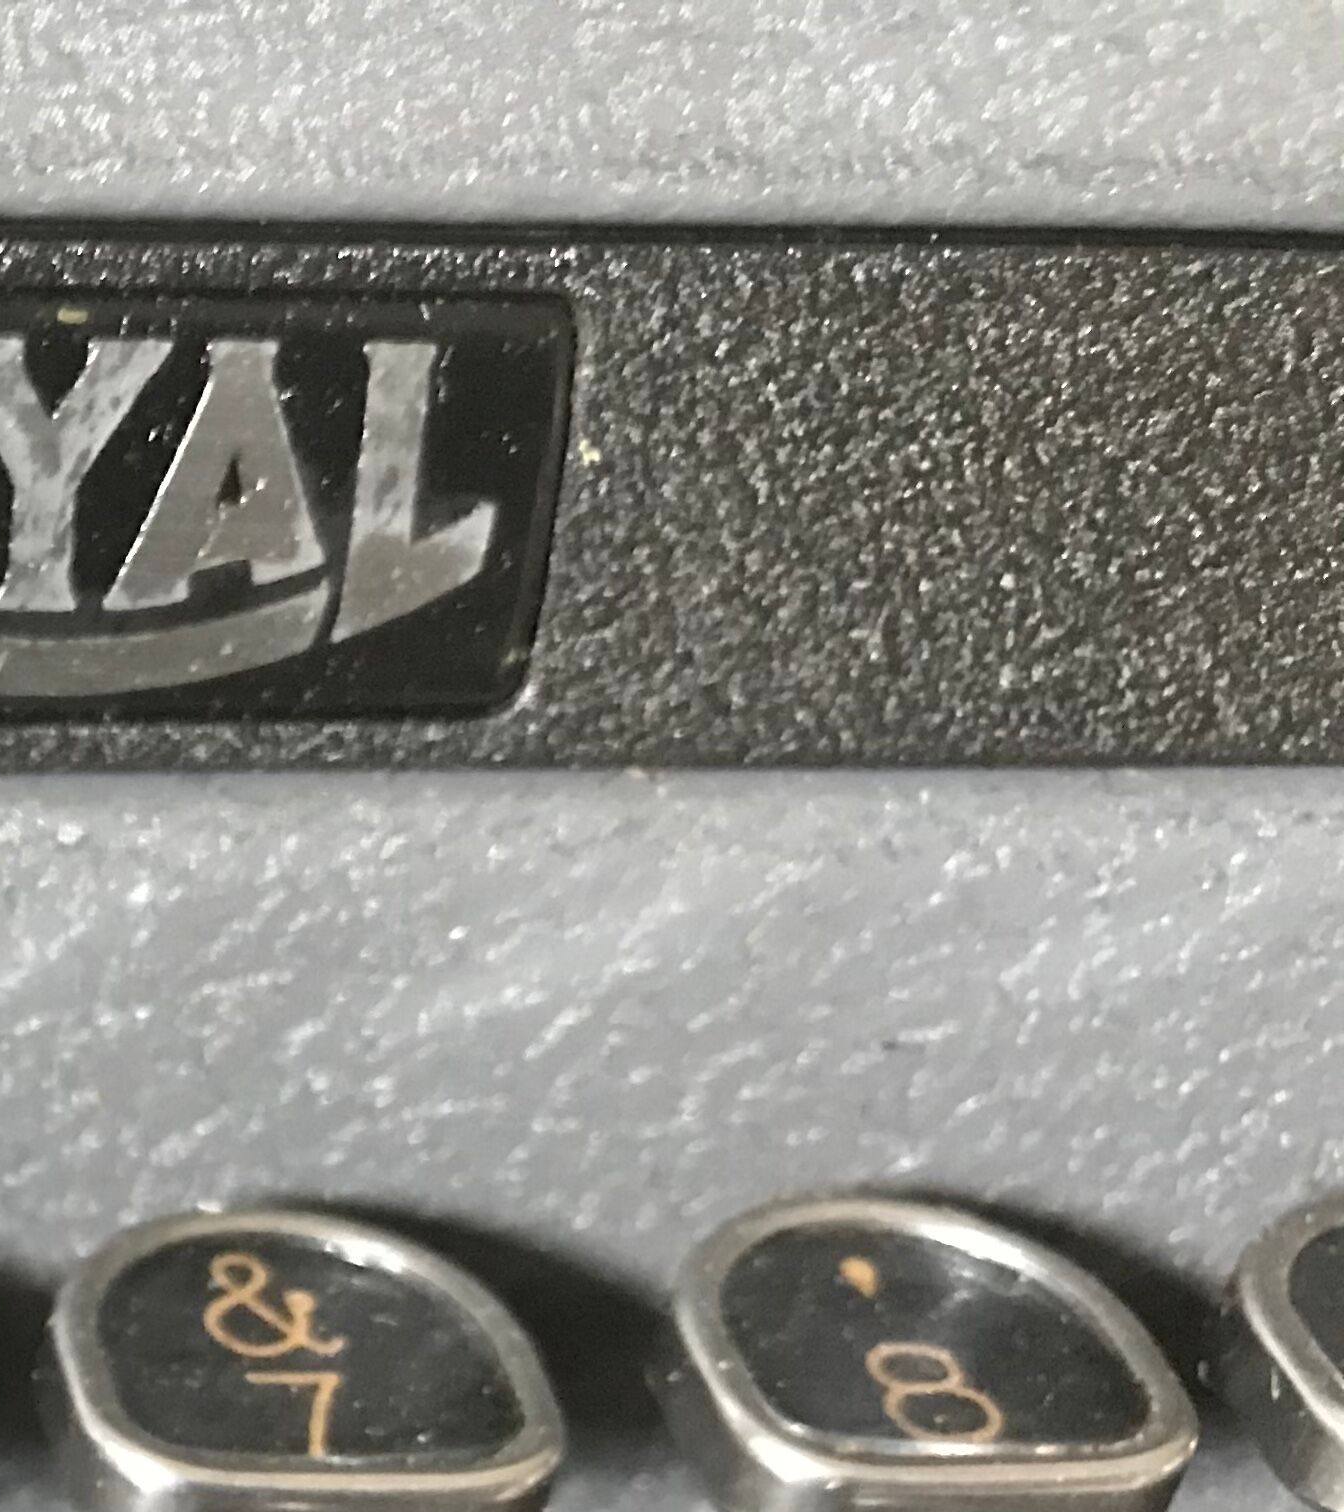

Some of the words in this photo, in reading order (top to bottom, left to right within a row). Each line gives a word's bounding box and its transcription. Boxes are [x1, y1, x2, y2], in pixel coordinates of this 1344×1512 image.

[204, 1252, 343, 1358] &
[248, 1371, 341, 1457] 7
[867, 1346, 1004, 1443] 8
